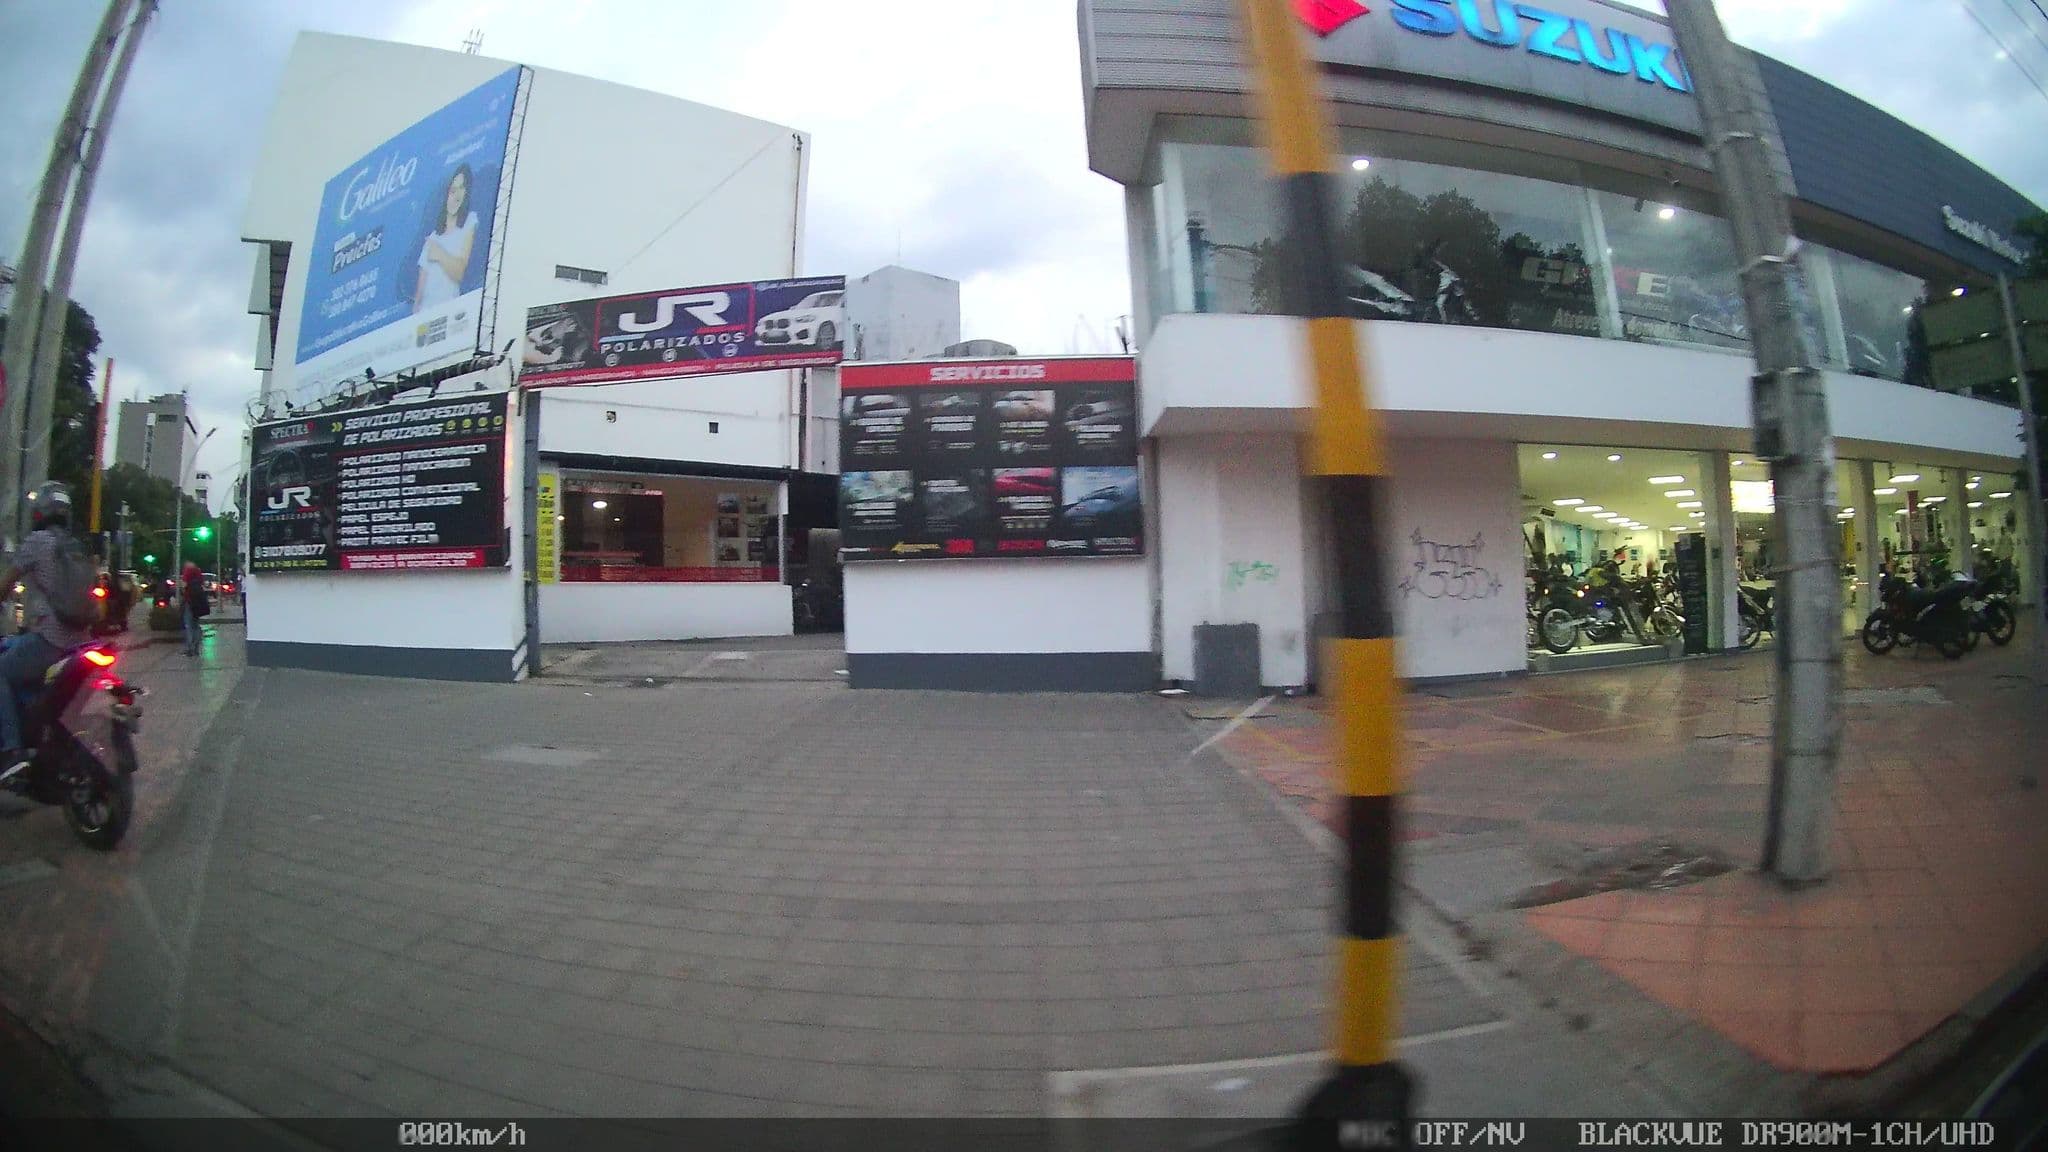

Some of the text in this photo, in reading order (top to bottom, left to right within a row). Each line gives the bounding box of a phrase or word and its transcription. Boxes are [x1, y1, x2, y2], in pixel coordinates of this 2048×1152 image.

[340, 150, 417, 220] Galileo
[618, 291, 731, 333] JR
[600, 332, 746, 354] POLARIZADOS
[930, 364, 1046, 381] SERVICIOS
[344, 401, 492, 430] SERVICIO PROFESIONAL
[343, 433, 359, 446] DE
[359, 423, 444, 444] POLARIZADOS
[342, 452, 401, 466] POLARIZADO
[342, 464, 401, 477] POLARIZADO
[342, 475, 400, 488] POLARIZADO
[268, 486, 311, 509] JR
[341, 487, 400, 500] POLARIZADO
[371, 511, 409, 522] ESPEJO
